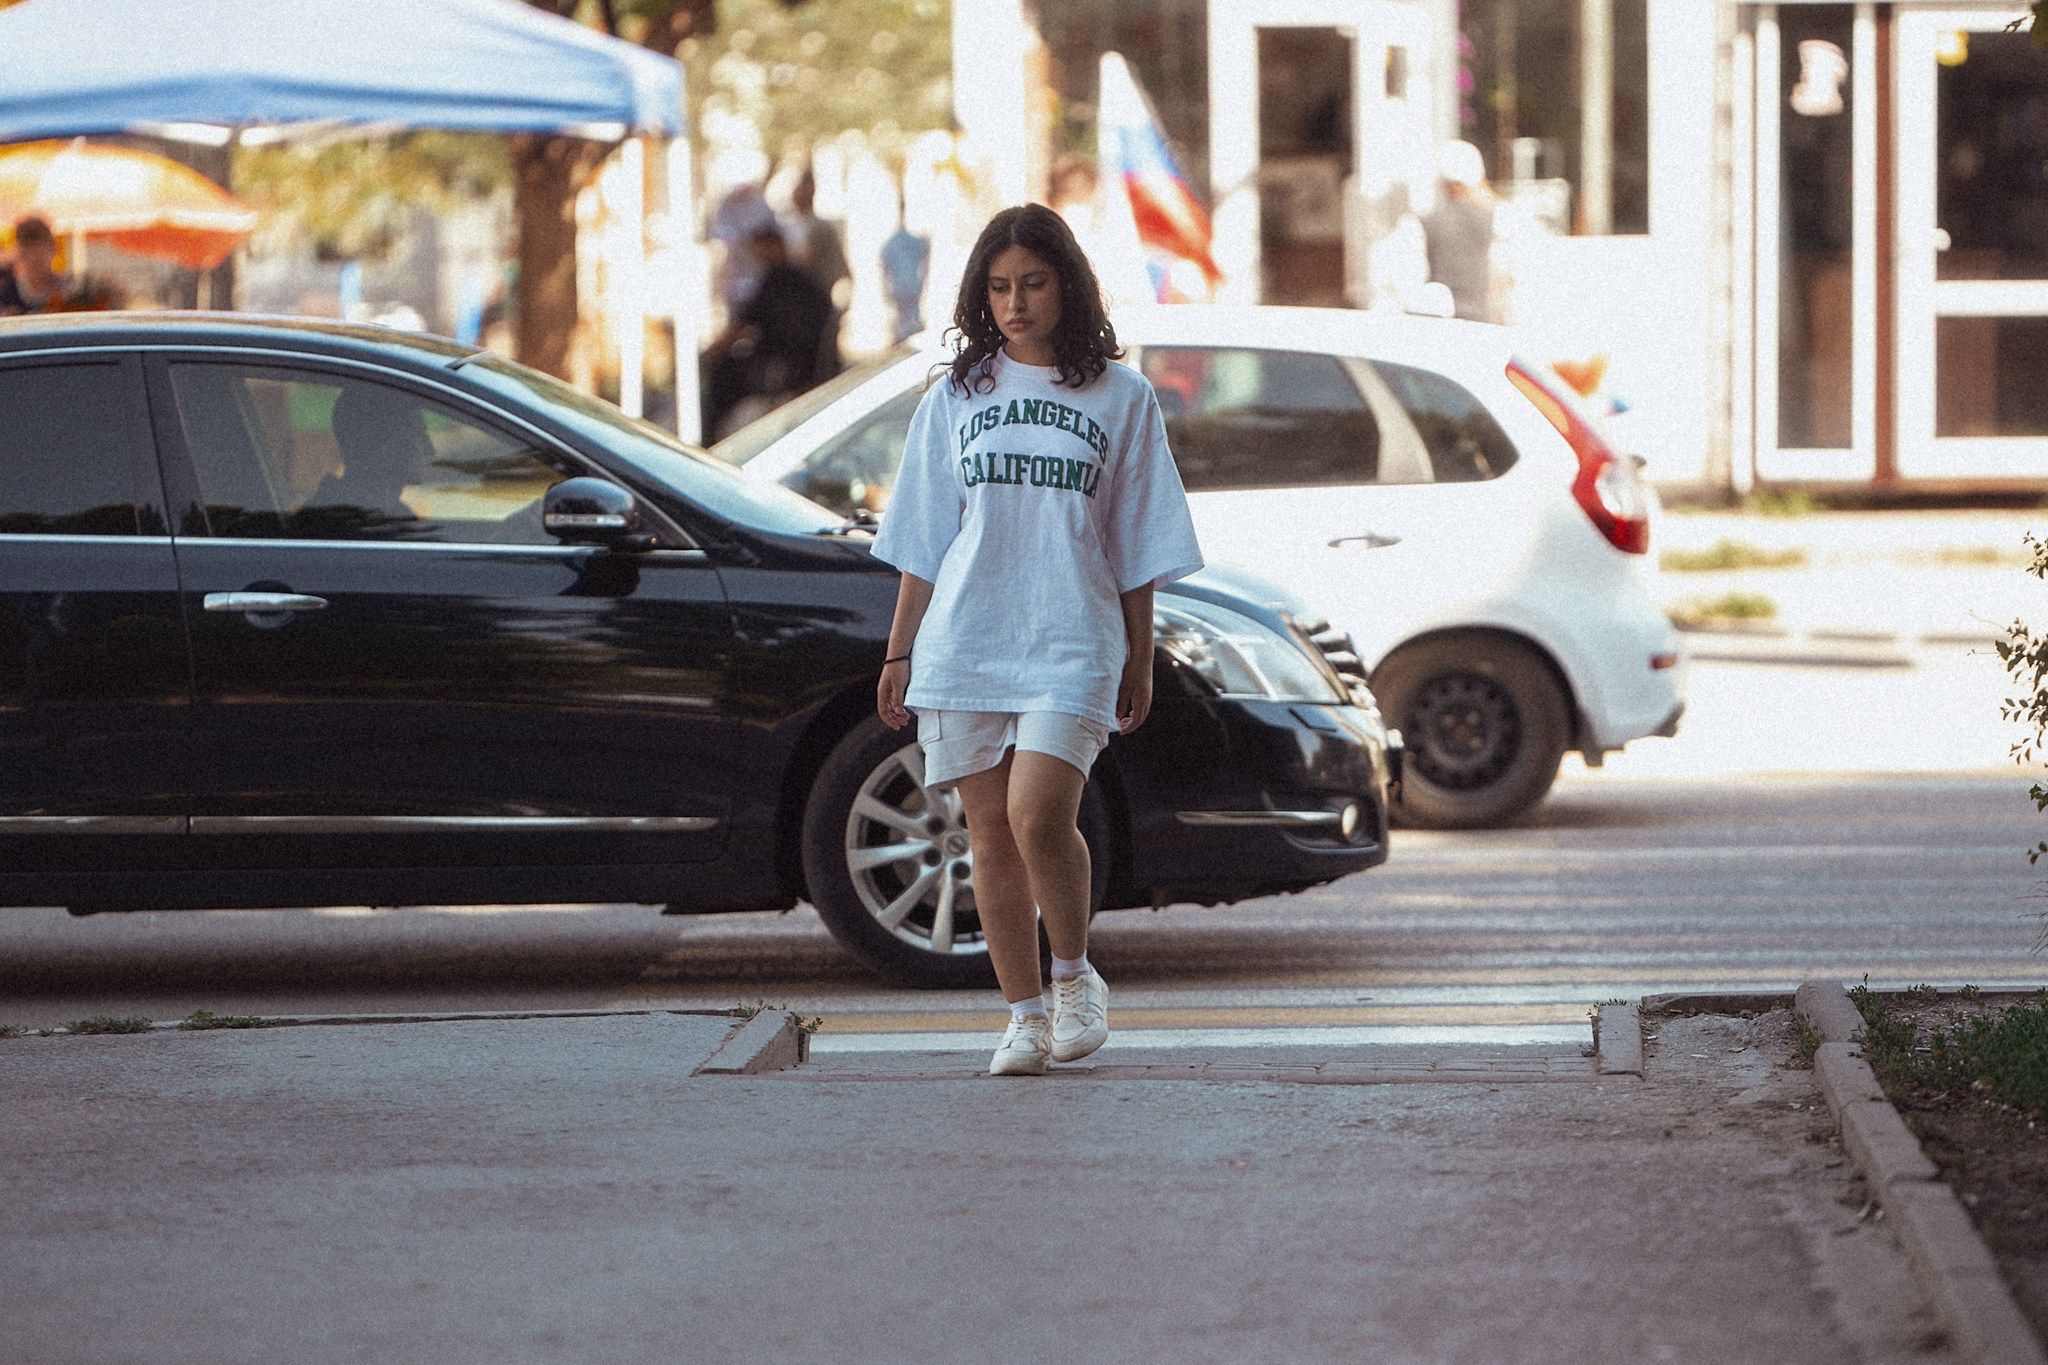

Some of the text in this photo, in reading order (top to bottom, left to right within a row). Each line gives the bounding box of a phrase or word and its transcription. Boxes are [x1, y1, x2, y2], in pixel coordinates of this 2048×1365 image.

[959, 399, 1108, 465] LOS ANGELES
[961, 452, 1101, 499] CALIFORNIA
